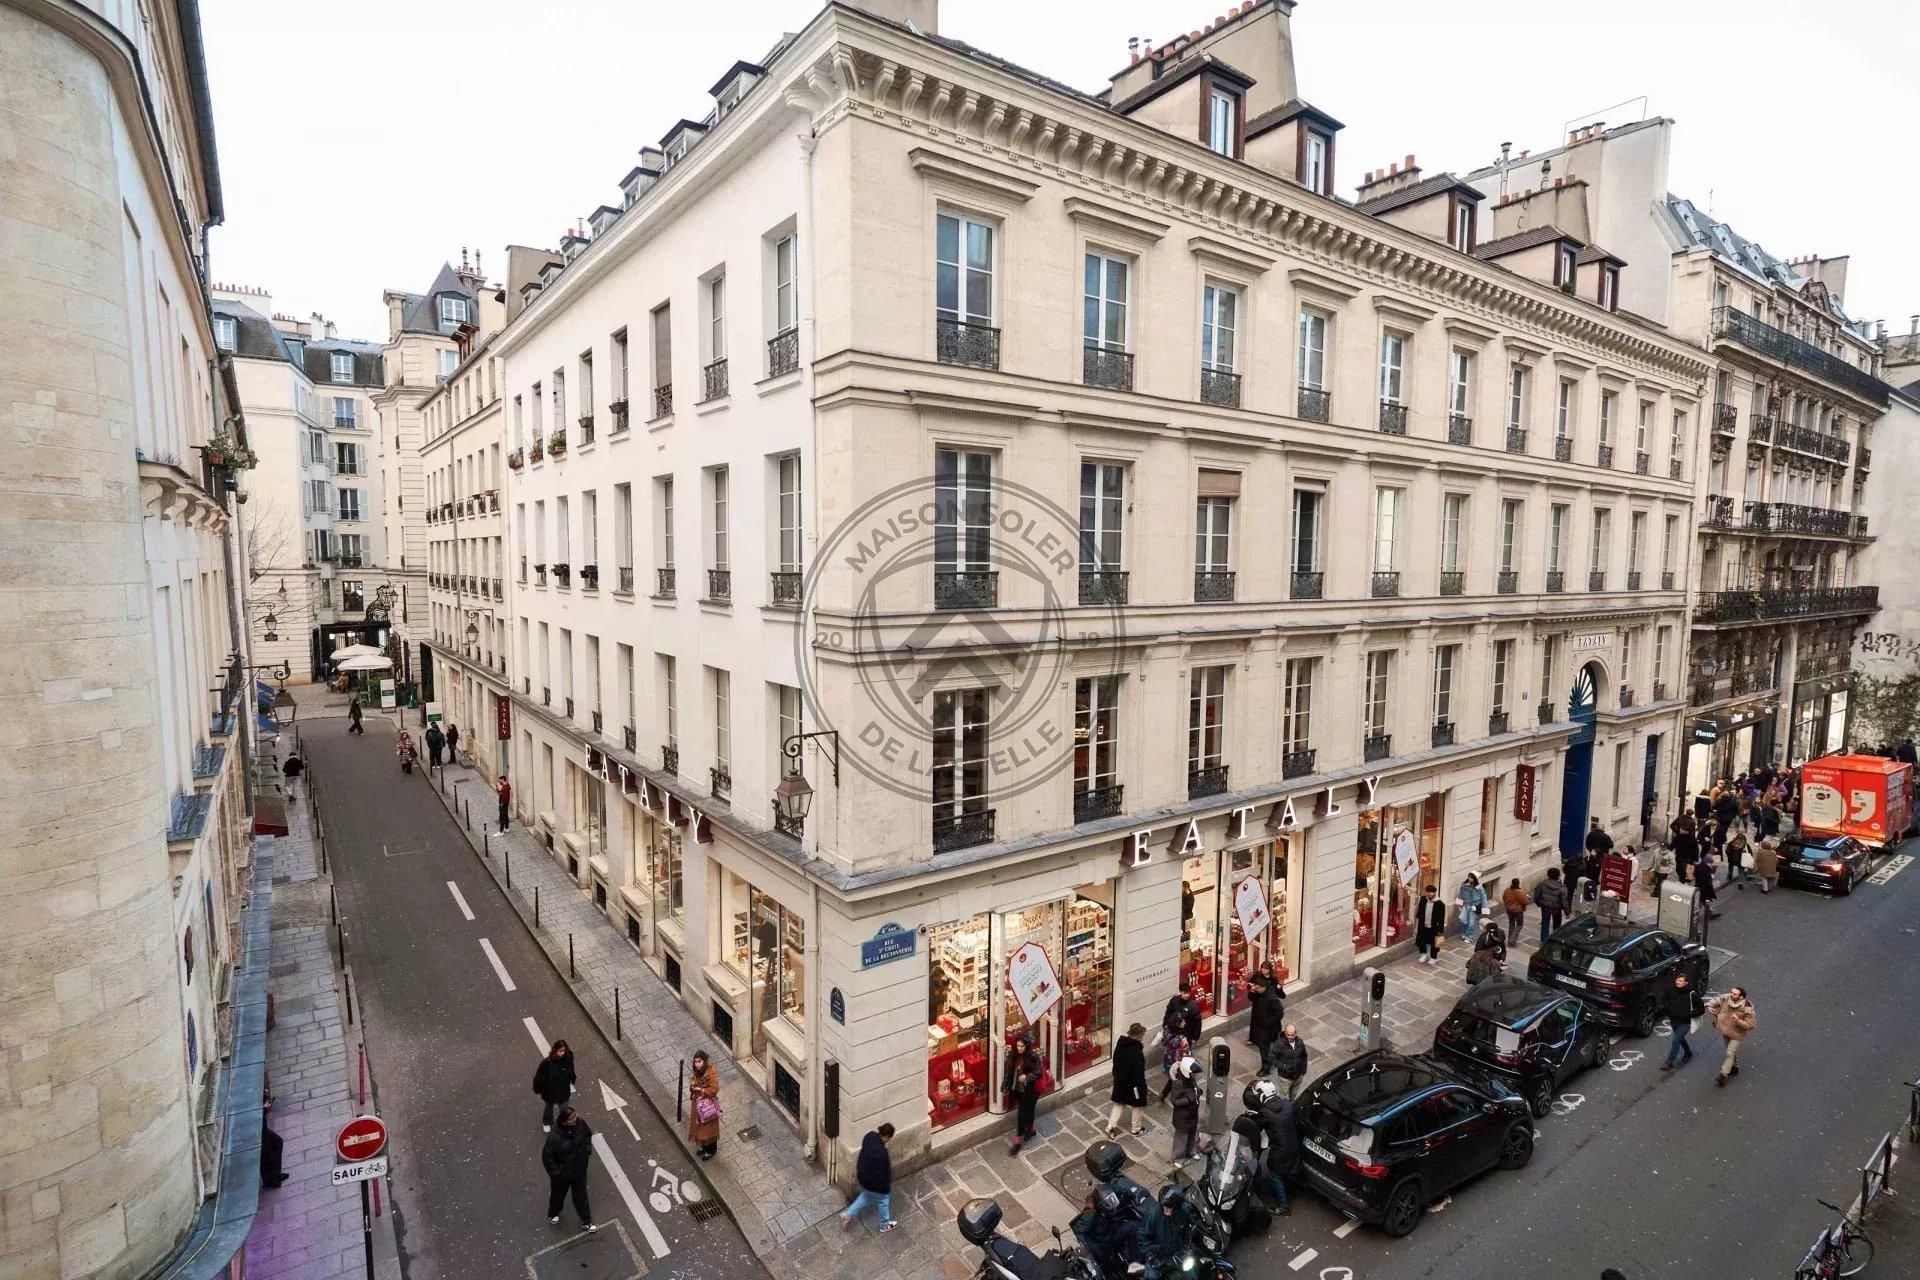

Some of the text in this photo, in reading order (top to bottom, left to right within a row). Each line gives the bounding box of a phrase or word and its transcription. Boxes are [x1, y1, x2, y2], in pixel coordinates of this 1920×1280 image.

[1579, 635, 1607, 647] EATALY
[585, 743, 703, 844] EATALY
[1521, 772, 1529, 814] EATALY
[1131, 775, 1382, 868] EATALY
[333, 1166, 364, 1180] SAUF
